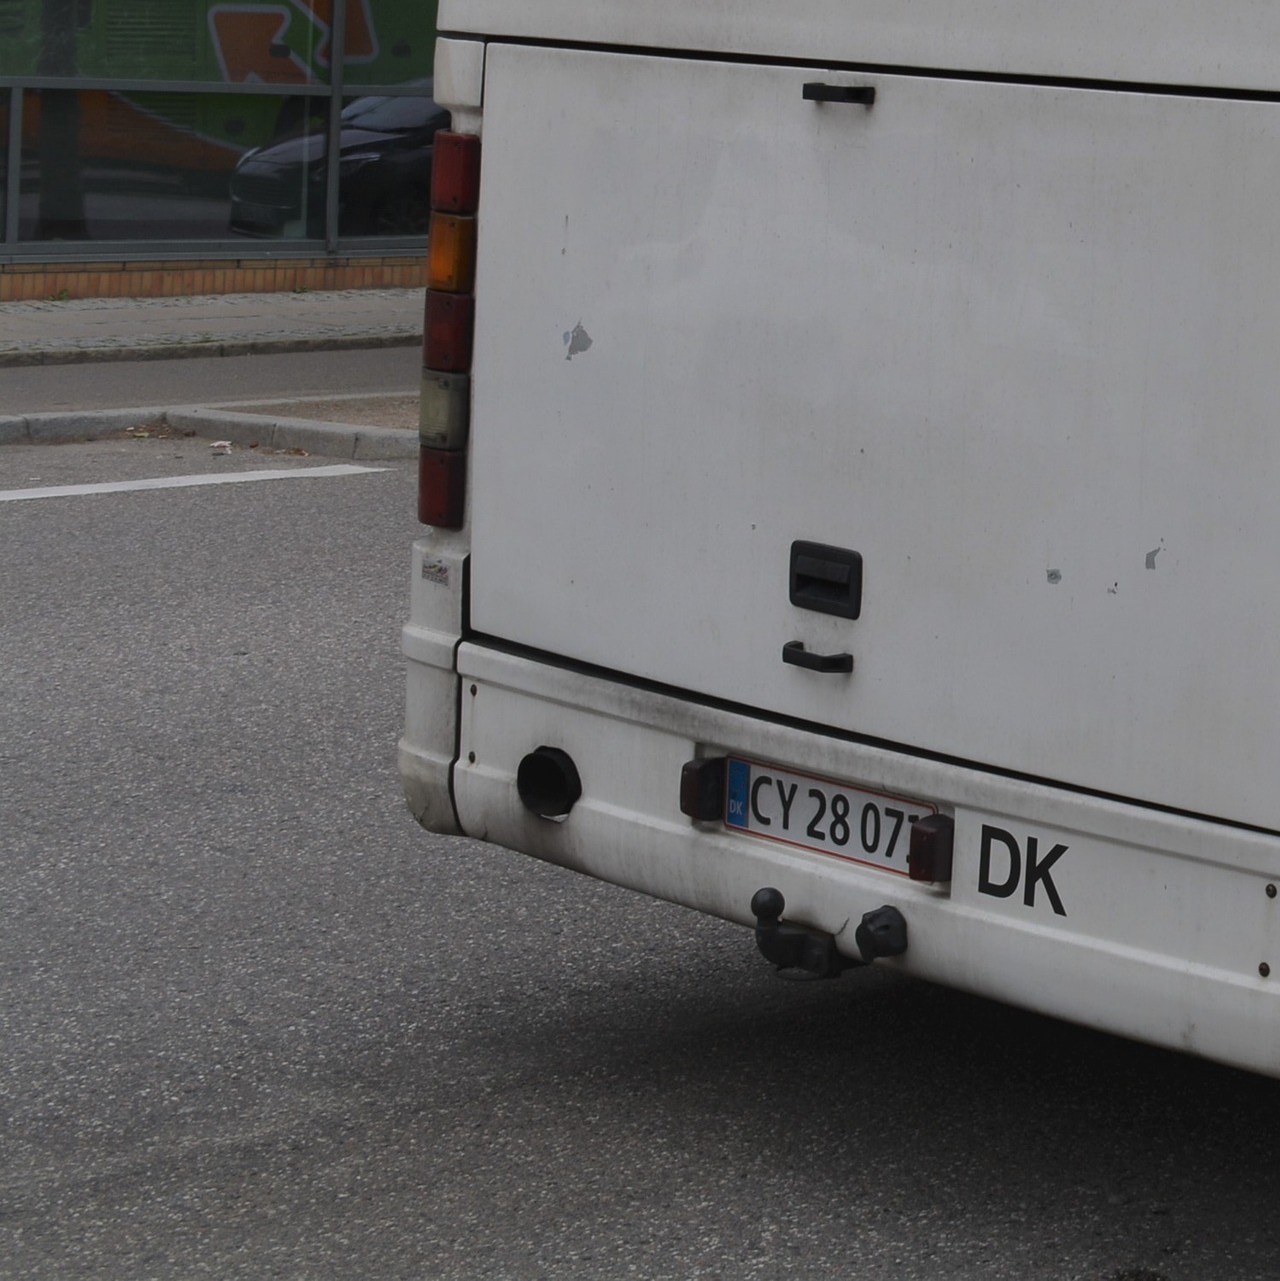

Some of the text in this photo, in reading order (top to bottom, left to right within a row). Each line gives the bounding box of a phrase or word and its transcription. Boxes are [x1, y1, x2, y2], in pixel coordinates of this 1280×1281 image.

[729, 798, 743, 816] DK
[751, 775, 799, 831] CY
[806, 788, 851, 847] 28
[978, 823, 1070, 918] DK
